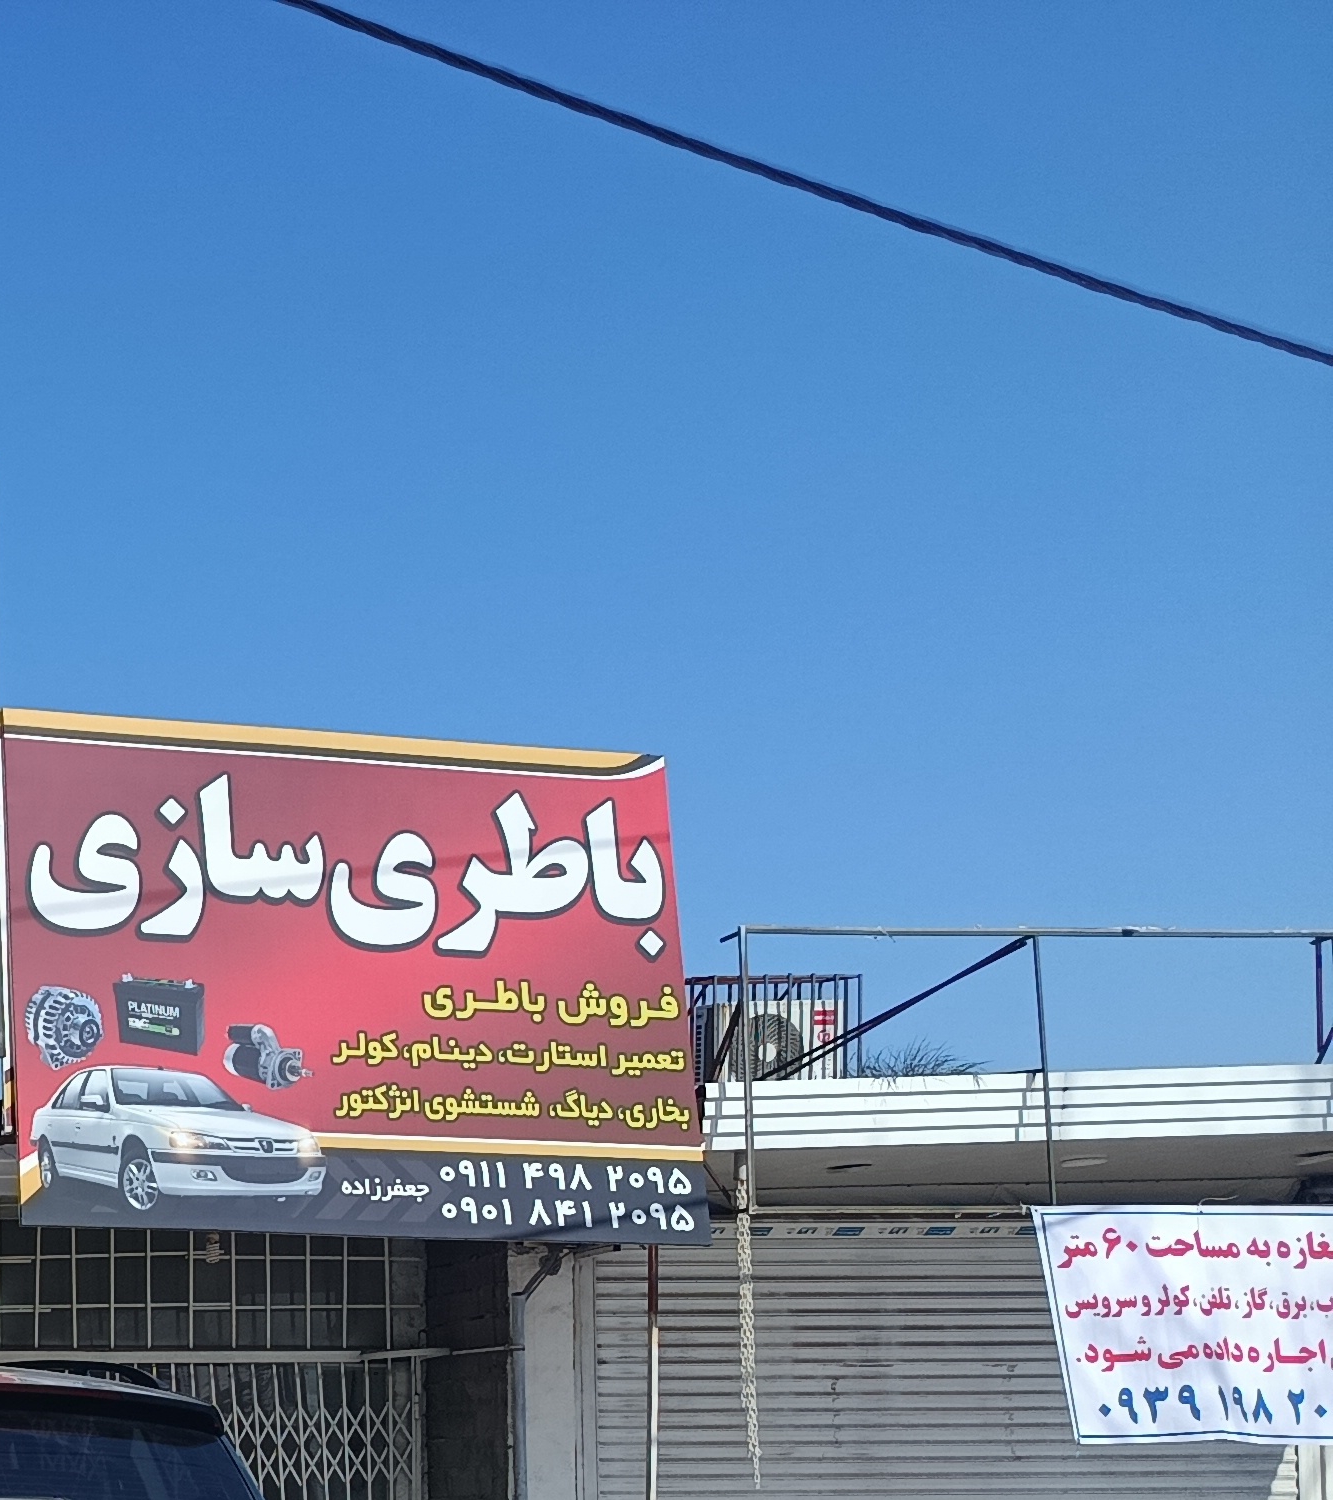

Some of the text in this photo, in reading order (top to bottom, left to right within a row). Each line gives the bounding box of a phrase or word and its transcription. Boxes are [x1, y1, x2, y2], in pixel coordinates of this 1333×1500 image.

[30, 773, 665, 959] باطری سازی
[128, 1001, 180, 1018] PLATINUM
[423, 980, 680, 1027] فروش باطری
[332, 1032, 399, 1064] کولر
[611, 1047, 686, 1075] تعمیر
[335, 1084, 419, 1118] انژکتور
[425, 1088, 540, 1120] شستشوی
[341, 1178, 430, 1203] جعفرزاده
[439, 1160, 692, 1195] ۰۹۱۱ ۴۹۸ ۲۰۹۵
[442, 1196, 695, 1232] ۰۹۰۱ ۸۴۱ ۲۰۹۵
[1057, 1227, 1333, 1269] غازه به مساحت ۶۰ متر
[1065, 1293, 1137, 1318] سرویس
[1156, 1284, 1189, 1315] کولر
[1158, 1343, 1200, 1369] می
[1202, 1336, 1244, 1363] داده
[1248, 1337, 1326, 1372] اجاره
[1099, 1384, 1201, 1424] ۰۹۳۹
[1218, 1385, 1273, 1424] ۱۹۸
